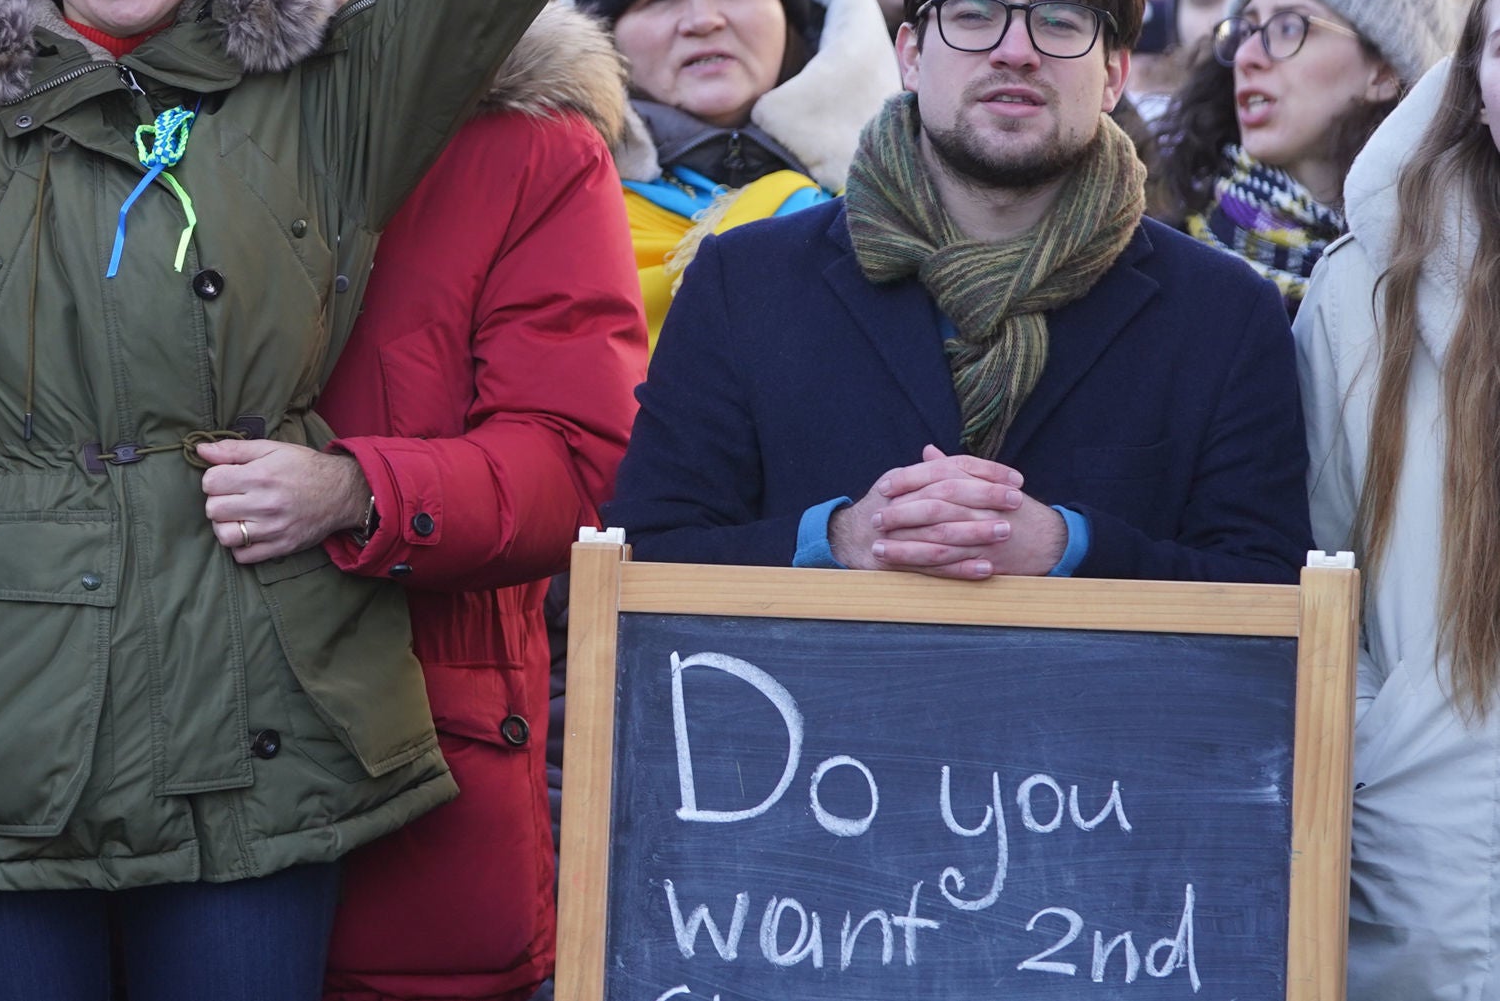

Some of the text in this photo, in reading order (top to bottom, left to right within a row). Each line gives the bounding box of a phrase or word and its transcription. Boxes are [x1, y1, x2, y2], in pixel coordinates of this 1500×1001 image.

[669, 650, 1133, 911] Do you
[662, 878, 1204, 993] want 2nd
